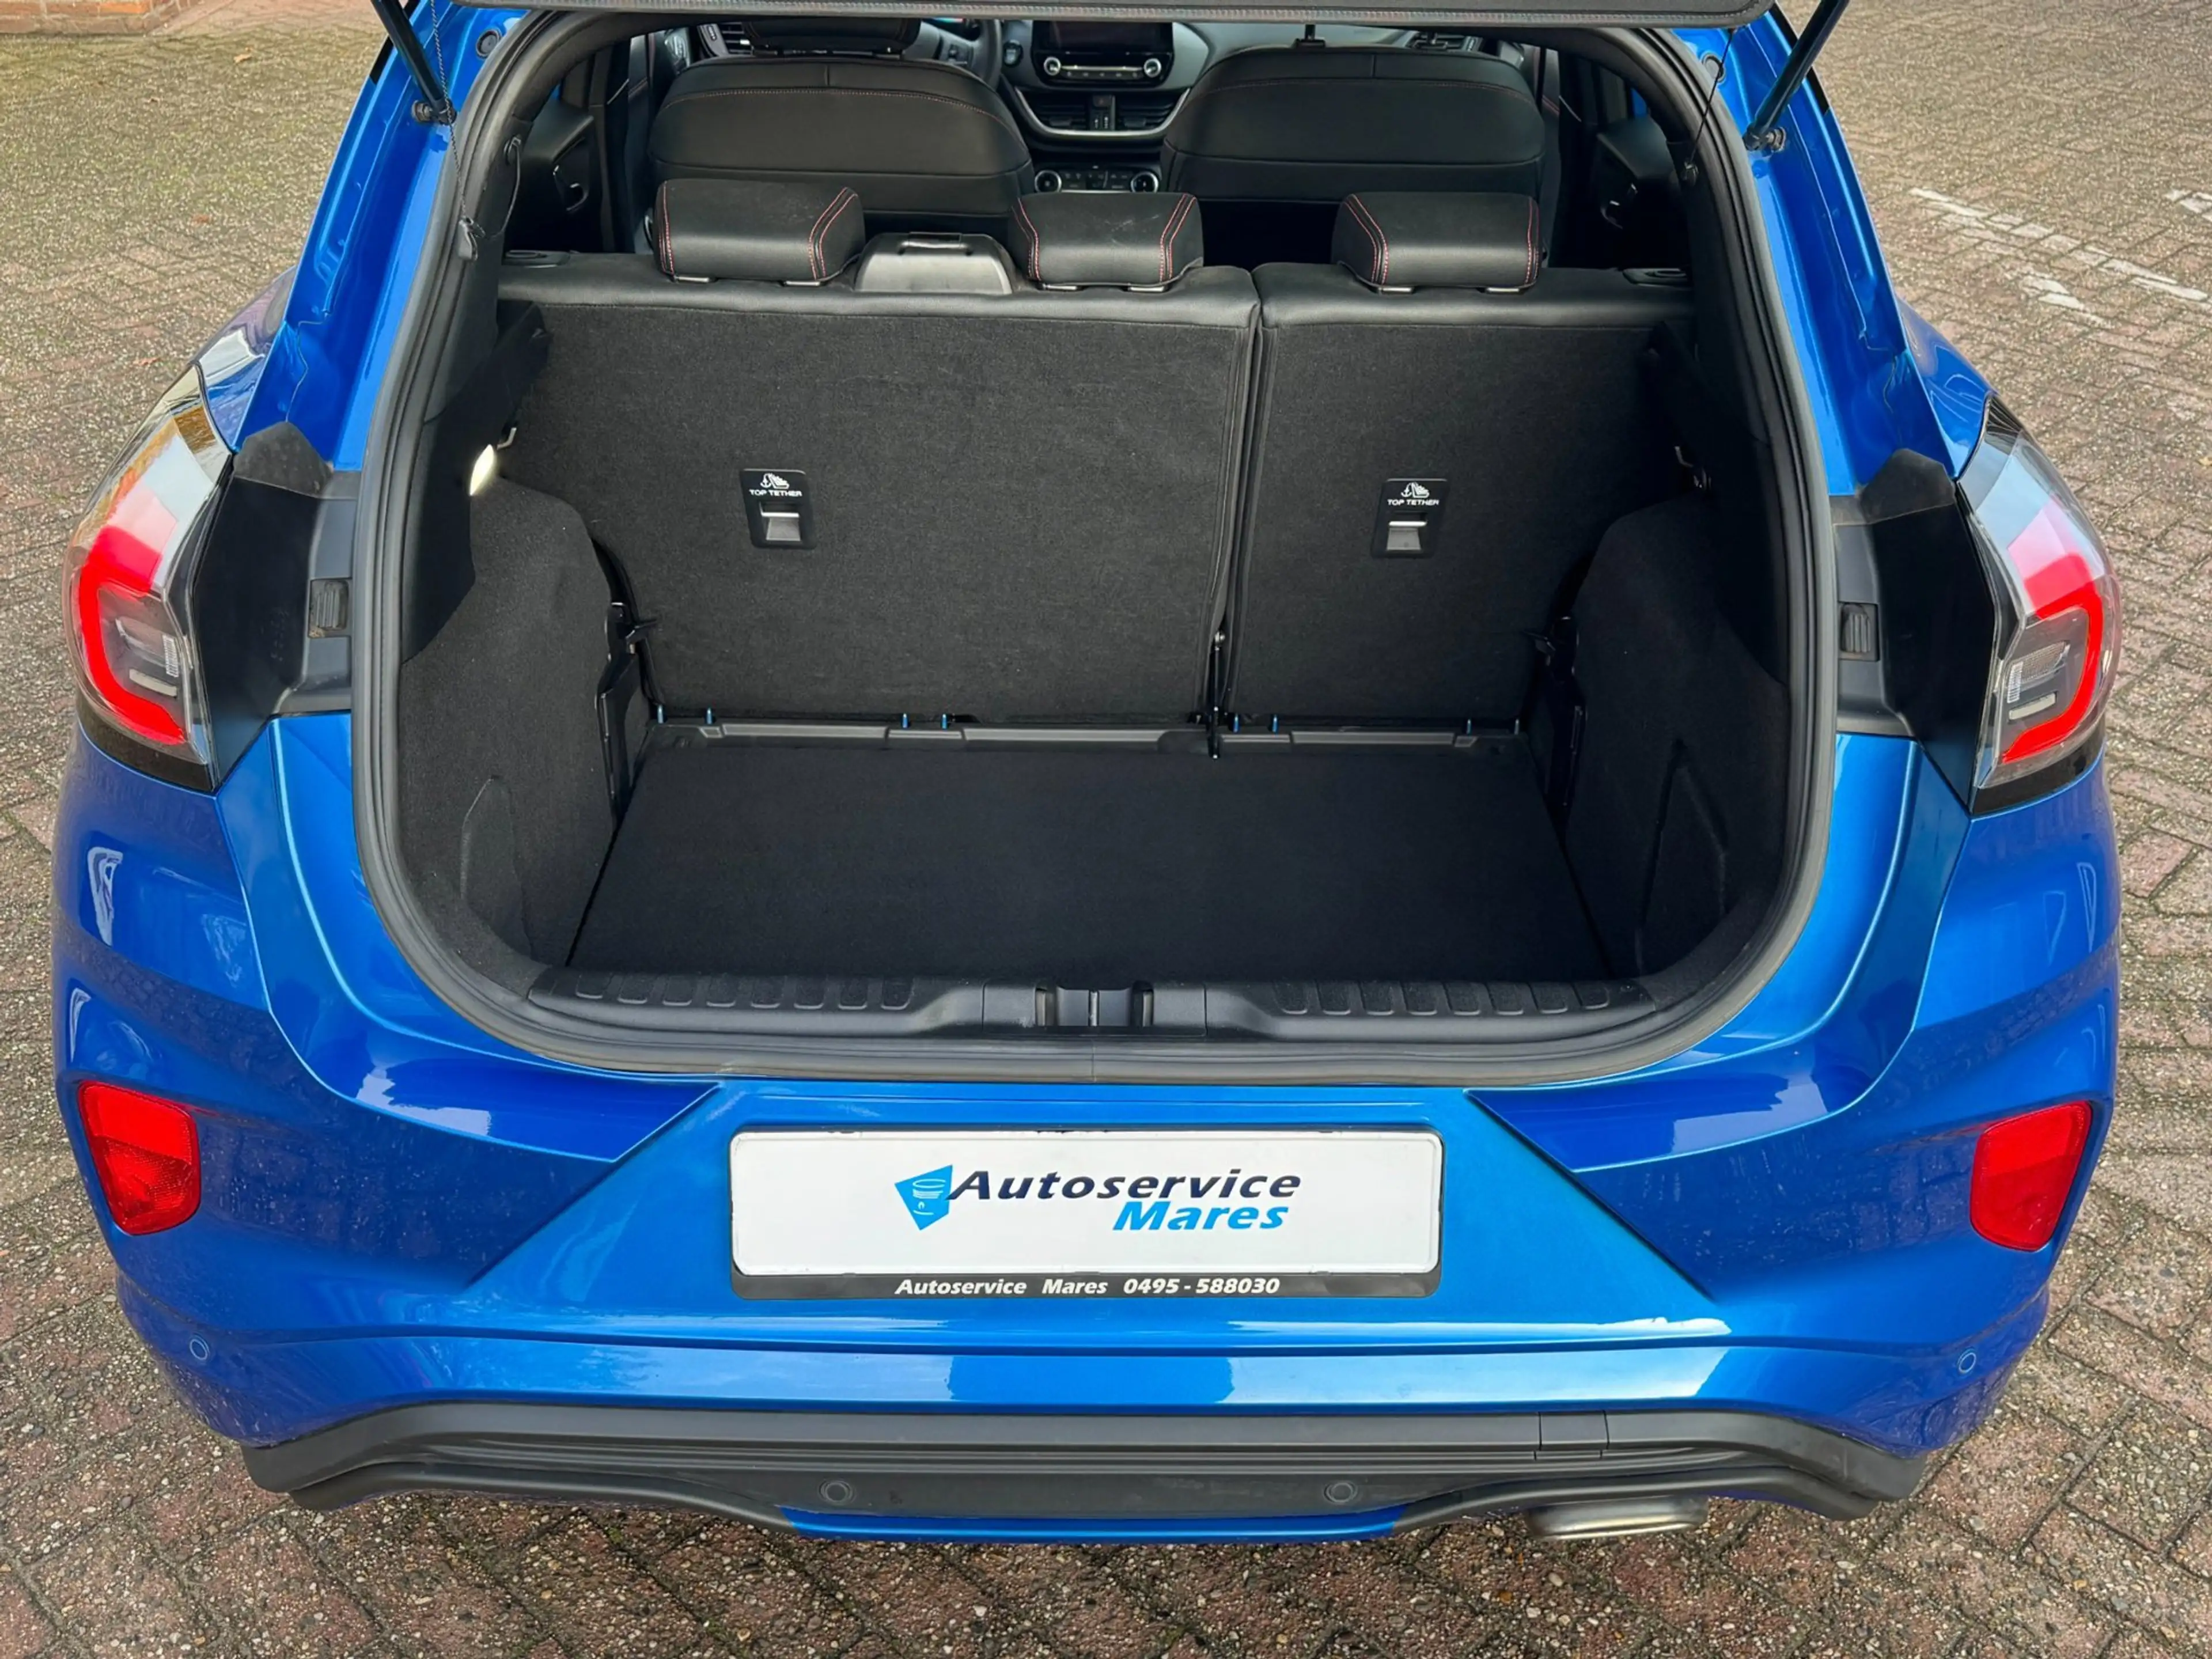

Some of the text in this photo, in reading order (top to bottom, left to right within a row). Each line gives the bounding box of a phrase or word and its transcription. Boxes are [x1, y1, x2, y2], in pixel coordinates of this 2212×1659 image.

[946, 1169, 1300, 1200] Autoservice
[1113, 1202, 1288, 1230] Mares
[894, 1278, 1027, 1295] Autoservice
[1041, 1278, 1108, 1295] Mares
[1123, 1278, 1180, 1294] 0495
[1195, 1278, 1280, 1294] 588030
